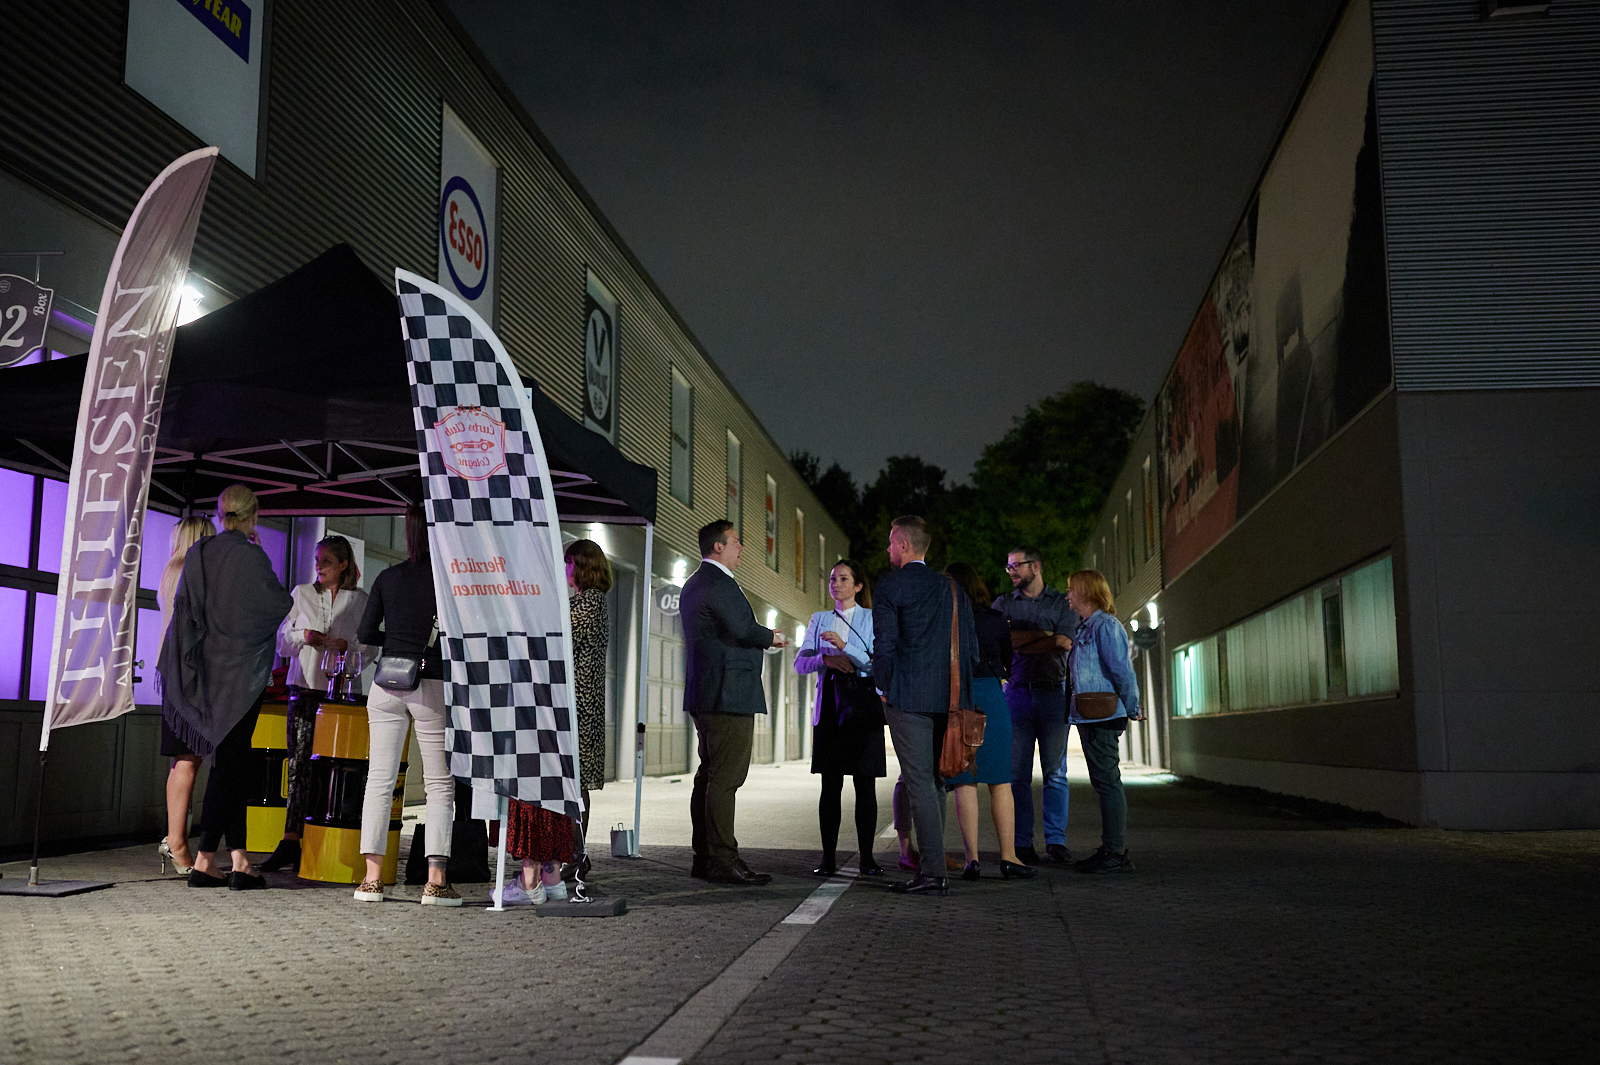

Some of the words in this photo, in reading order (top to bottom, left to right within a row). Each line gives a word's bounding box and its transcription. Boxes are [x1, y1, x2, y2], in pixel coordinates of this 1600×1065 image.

[33, 292, 48, 316] Box
[0, 304, 28, 348] 2
[660, 593, 680, 610] 05
